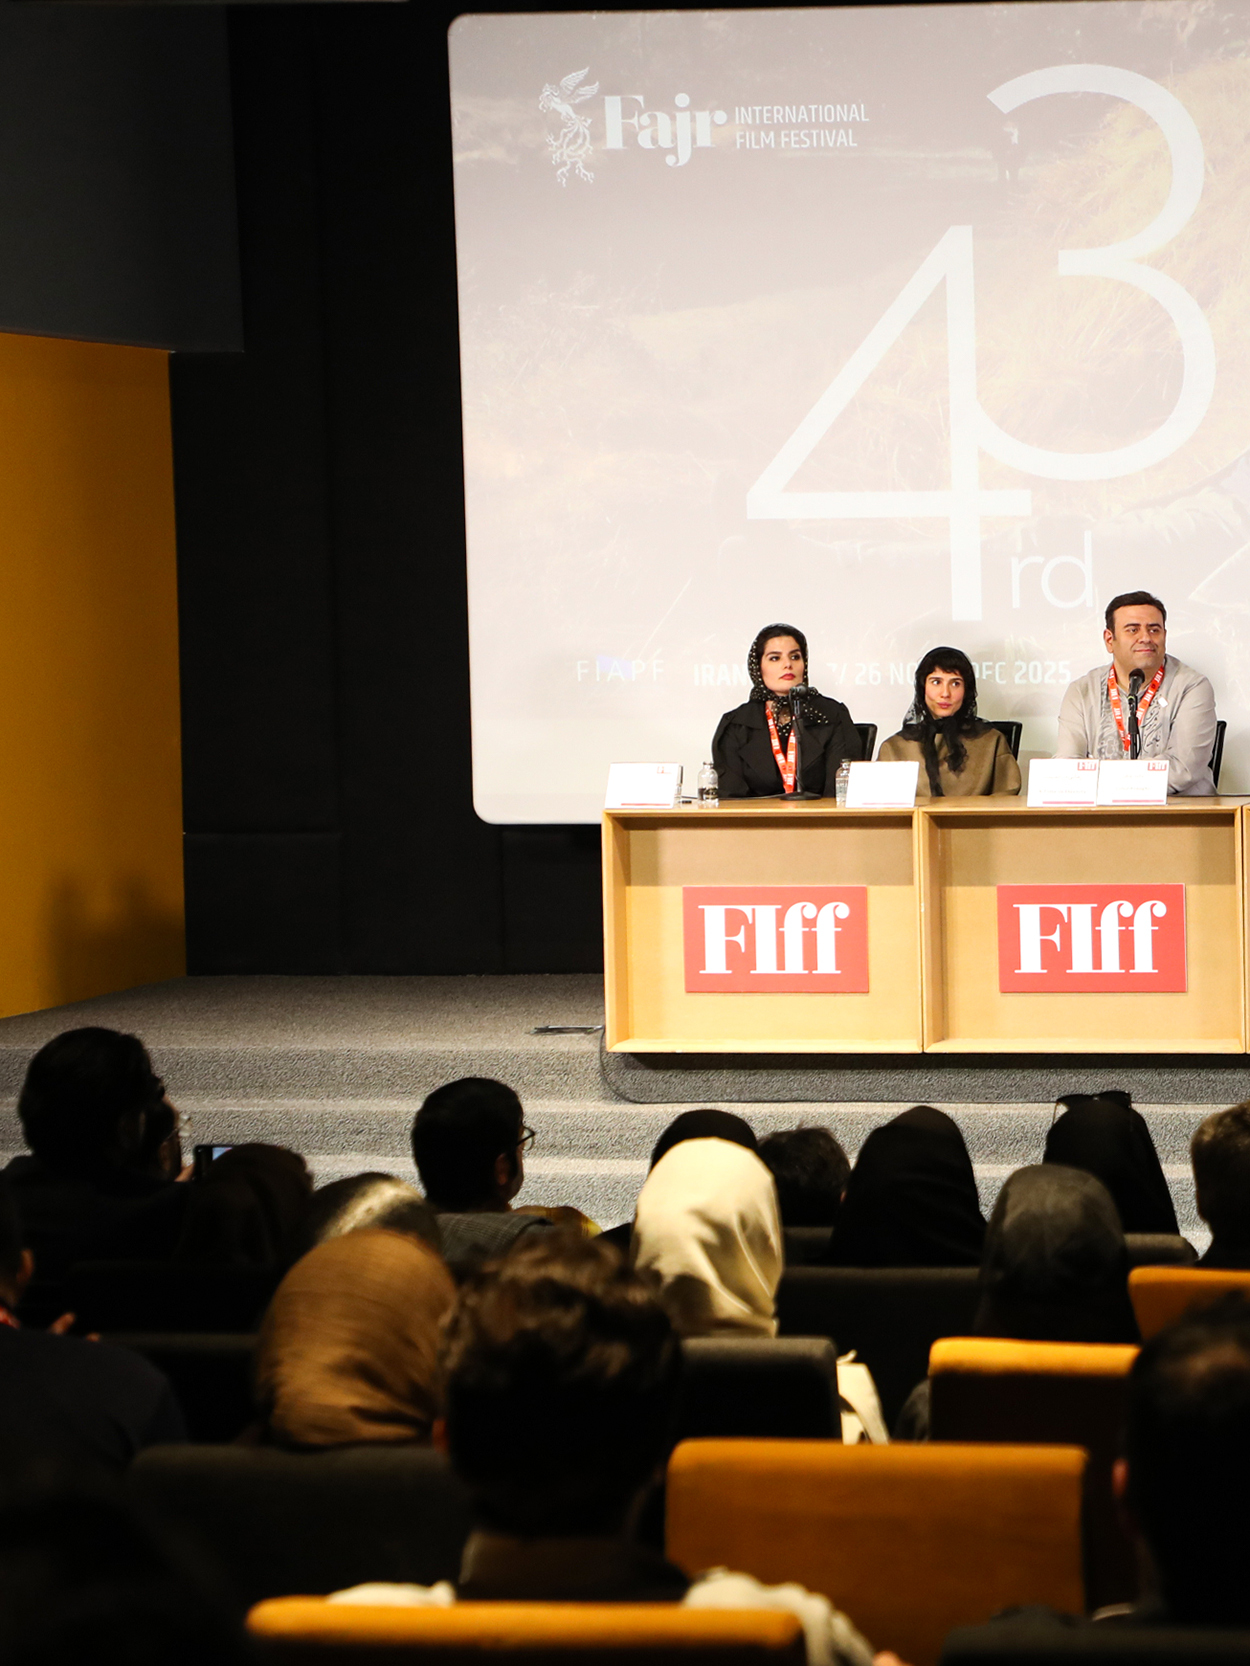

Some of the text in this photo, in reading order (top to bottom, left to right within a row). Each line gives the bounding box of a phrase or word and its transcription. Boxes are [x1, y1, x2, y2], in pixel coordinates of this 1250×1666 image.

[601, 93, 869, 167] Fajr INTERNATIONAL
[736, 128, 858, 149] FILM FESTIVAL
[576, 659, 665, 683] FIAPF
[855, 662, 882, 686] 26
[889, 662, 919, 686] NO
[1014, 660, 1072, 685] 2025
[698, 901, 850, 974] FIff
[1013, 900, 1167, 973] FIff
